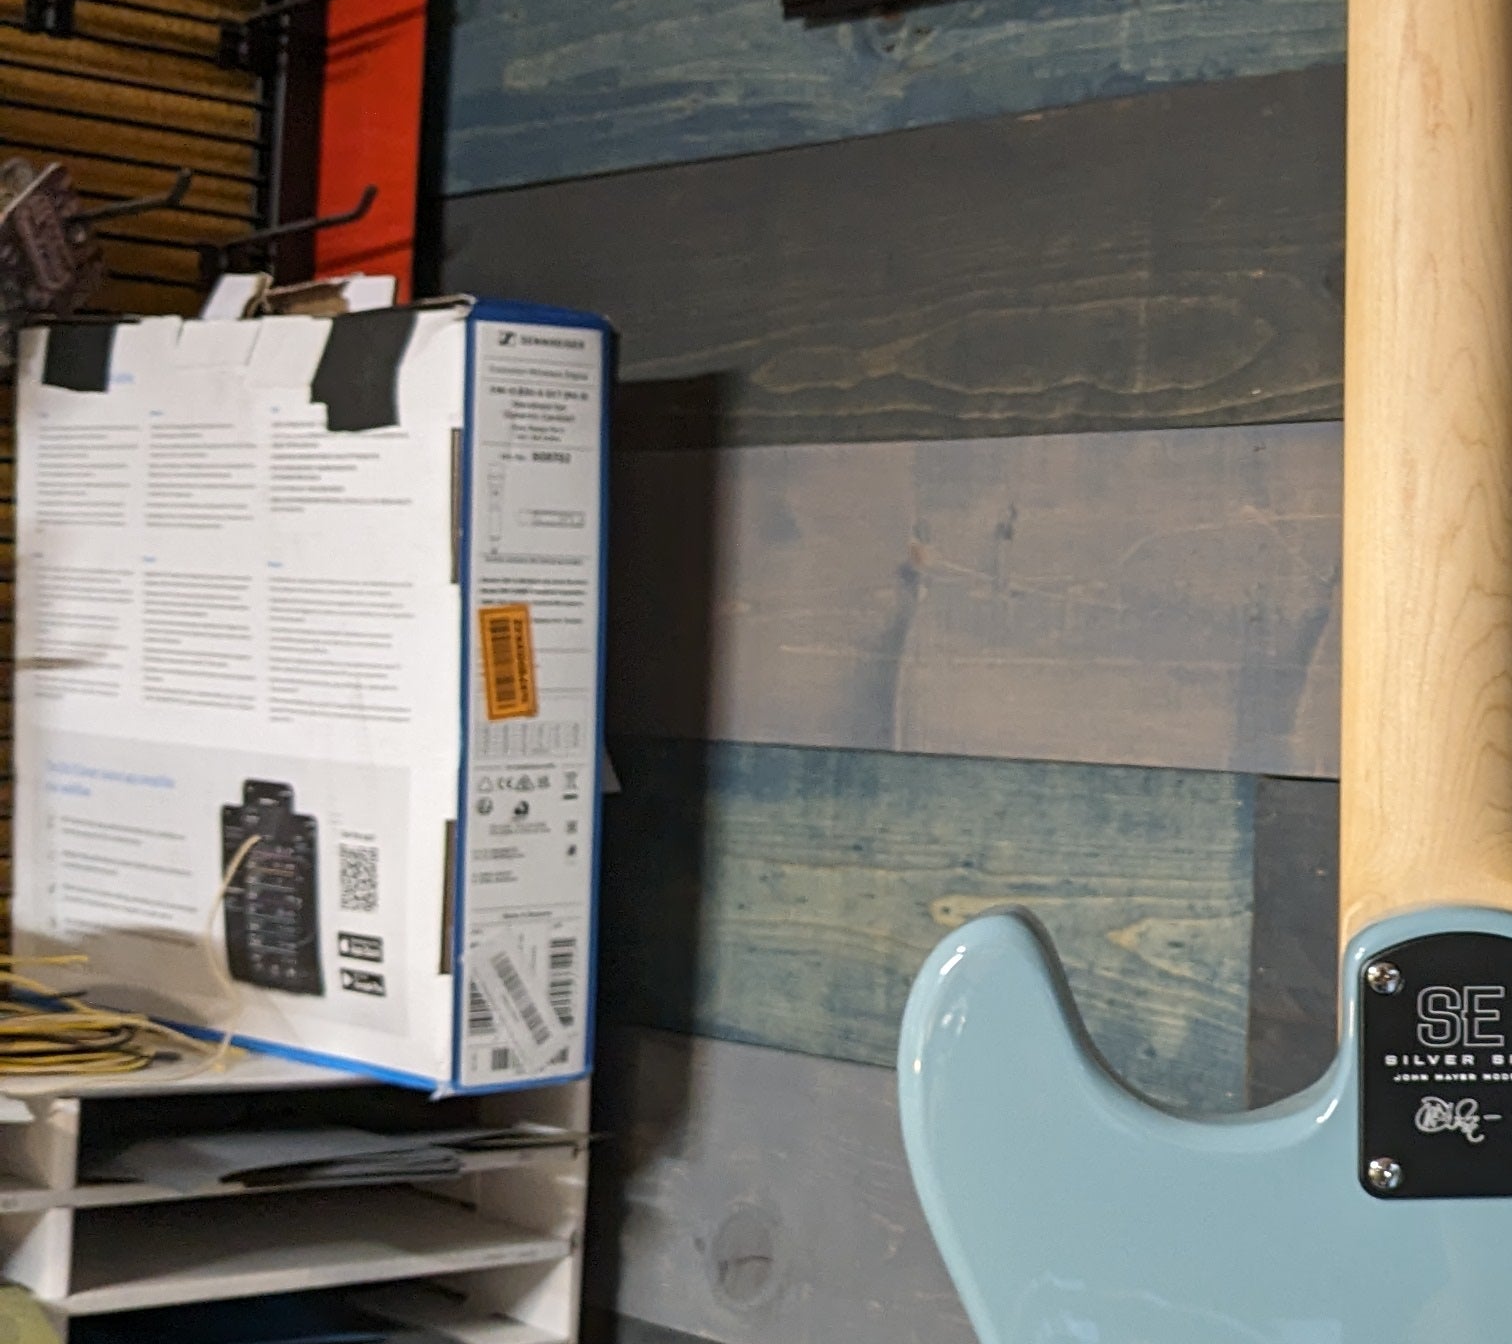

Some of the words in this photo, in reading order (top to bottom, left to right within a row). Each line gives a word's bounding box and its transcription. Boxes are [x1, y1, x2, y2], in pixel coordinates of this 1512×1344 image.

[1416, 985, 1506, 1048] SE
[1384, 1054, 1475, 1066] SILVER
[1393, 1072, 1429, 1081] JOHN
[1434, 1072, 1477, 1081] MAYER
